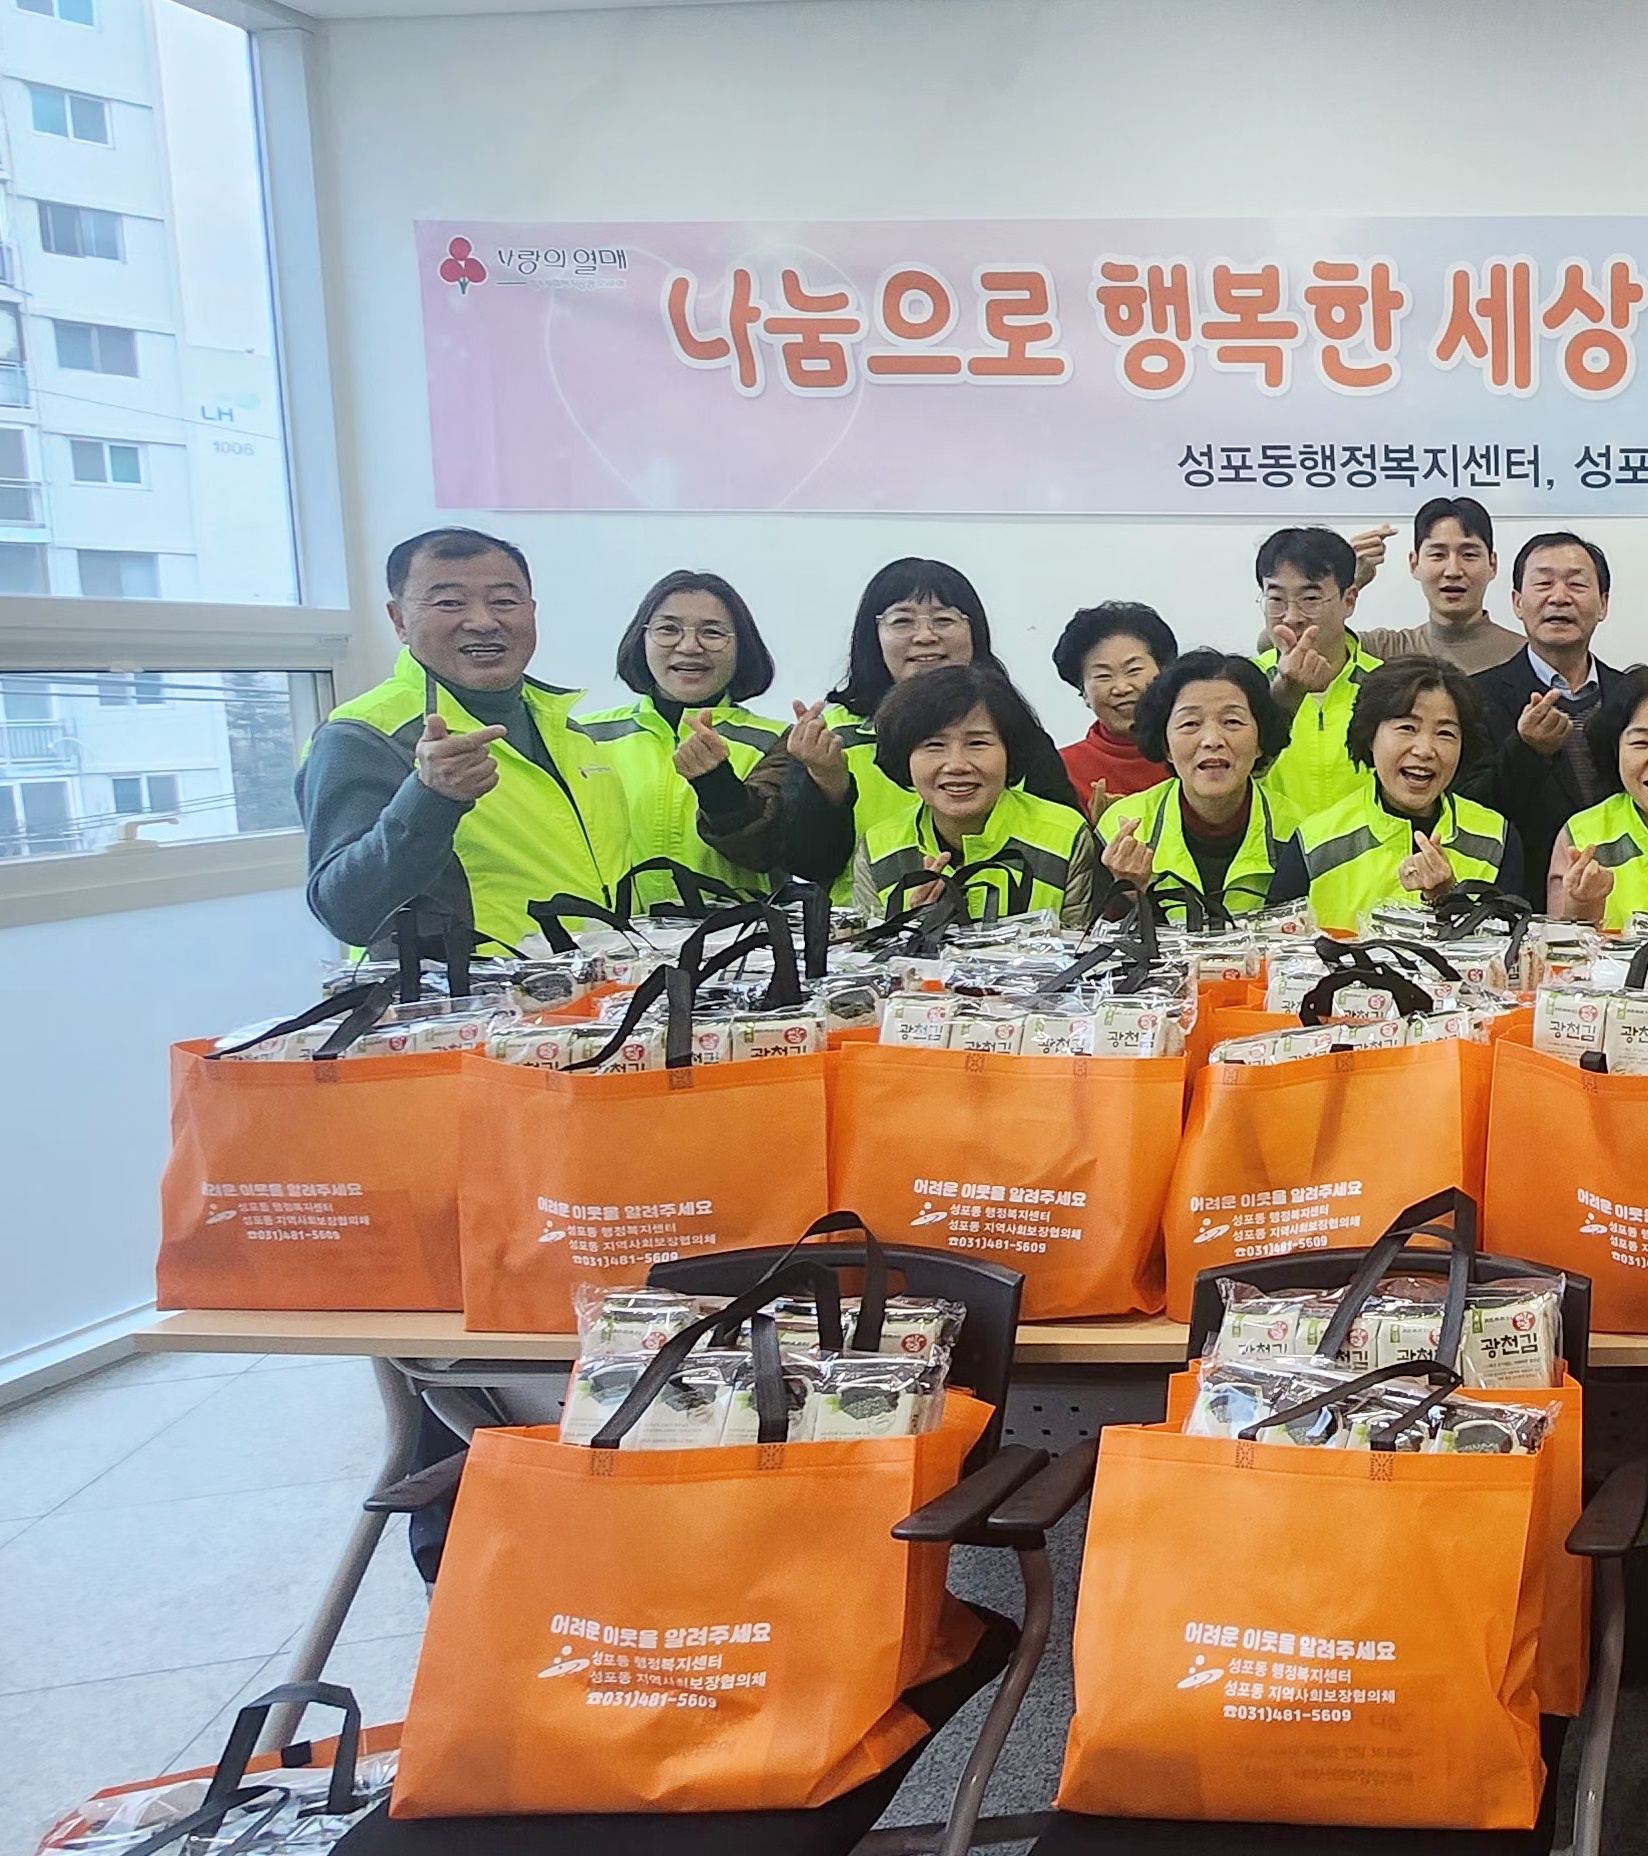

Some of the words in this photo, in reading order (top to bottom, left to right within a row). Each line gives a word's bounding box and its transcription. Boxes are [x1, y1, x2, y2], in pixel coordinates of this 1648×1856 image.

[669, 267, 1066, 390] 나눔으로
[1096, 261, 1402, 391] 행복한
[1437, 261, 1645, 391] 세상
[201, 405, 235, 422] LH
[212, 440, 255, 456] 1006
[1177, 443, 1556, 492] 성포동행정복지센터,
[901, 1023, 943, 1040] 광천김
[1107, 1030, 1155, 1049] 광천김
[1550, 1020, 1597, 1042] 광천김
[914, 1178, 958, 1198] 어려운
[961, 1183, 1006, 1201] 이웃을
[1009, 1187, 1087, 1207] 알려주세요
[1190, 1195, 1237, 1212] 어려운
[1240, 1189, 1287, 1207] 이웃을
[1290, 1180, 1362, 1203] 알려주세요
[1577, 1188, 1613, 1215] 어려운
[572, 1205, 620, 1221] 이웃을
[624, 1200, 713, 1219] 알려주세요
[950, 1203, 982, 1218] 성포동
[985, 1207, 1051, 1223] 행정복지센터
[1232, 1212, 1266, 1227] 성포동
[1269, 1204, 1329, 1224] 행정복지센터
[567, 1224, 597, 1238] 성포동
[601, 1223, 677, 1238] 행정복지센터
[948, 1220, 980, 1233] 성포동
[984, 1222, 1082, 1241] 지역사회보장협의체
[1233, 1227, 1266, 1242] 성포동
[1270, 1215, 1361, 1238] 지역사회보장협의체
[1608, 1221, 1638, 1239] 성포동
[569, 1239, 599, 1252] 성포동
[603, 1233, 716, 1251] 지역사회보장협의체
[959, 1237, 1046, 1254] 031)481-5609
[1246, 1235, 1328, 1257] 031)481-5609
[1609, 1235, 1638, 1252] 성포동
[582, 1251, 679, 1267] 031)481-5609
[1480, 1333, 1539, 1359] 광천김
[550, 1614, 600, 1641] 어려운
[602, 1626, 658, 1649] 이웃을
[664, 1622, 771, 1649] 알려주세요
[1184, 1621, 1239, 1648] 어려운
[1242, 1628, 1295, 1656] 이웃을
[1299, 1636, 1396, 1661] 알려주세요
[592, 1650, 630, 1668] 성포동
[634, 1654, 723, 1672] 행정복지센터
[1228, 1658, 1267, 1677] 성포동
[1271, 1662, 1351, 1684] 행정복지센터
[590, 1670, 632, 1685] 성포동
[602, 1691, 717, 1709] 031)481-5609
[1224, 1680, 1264, 1699] 성포동
[1268, 1685, 1396, 1704] 지역사회보장협의체
[1237, 1705, 1351, 1722] 031)481-5609
